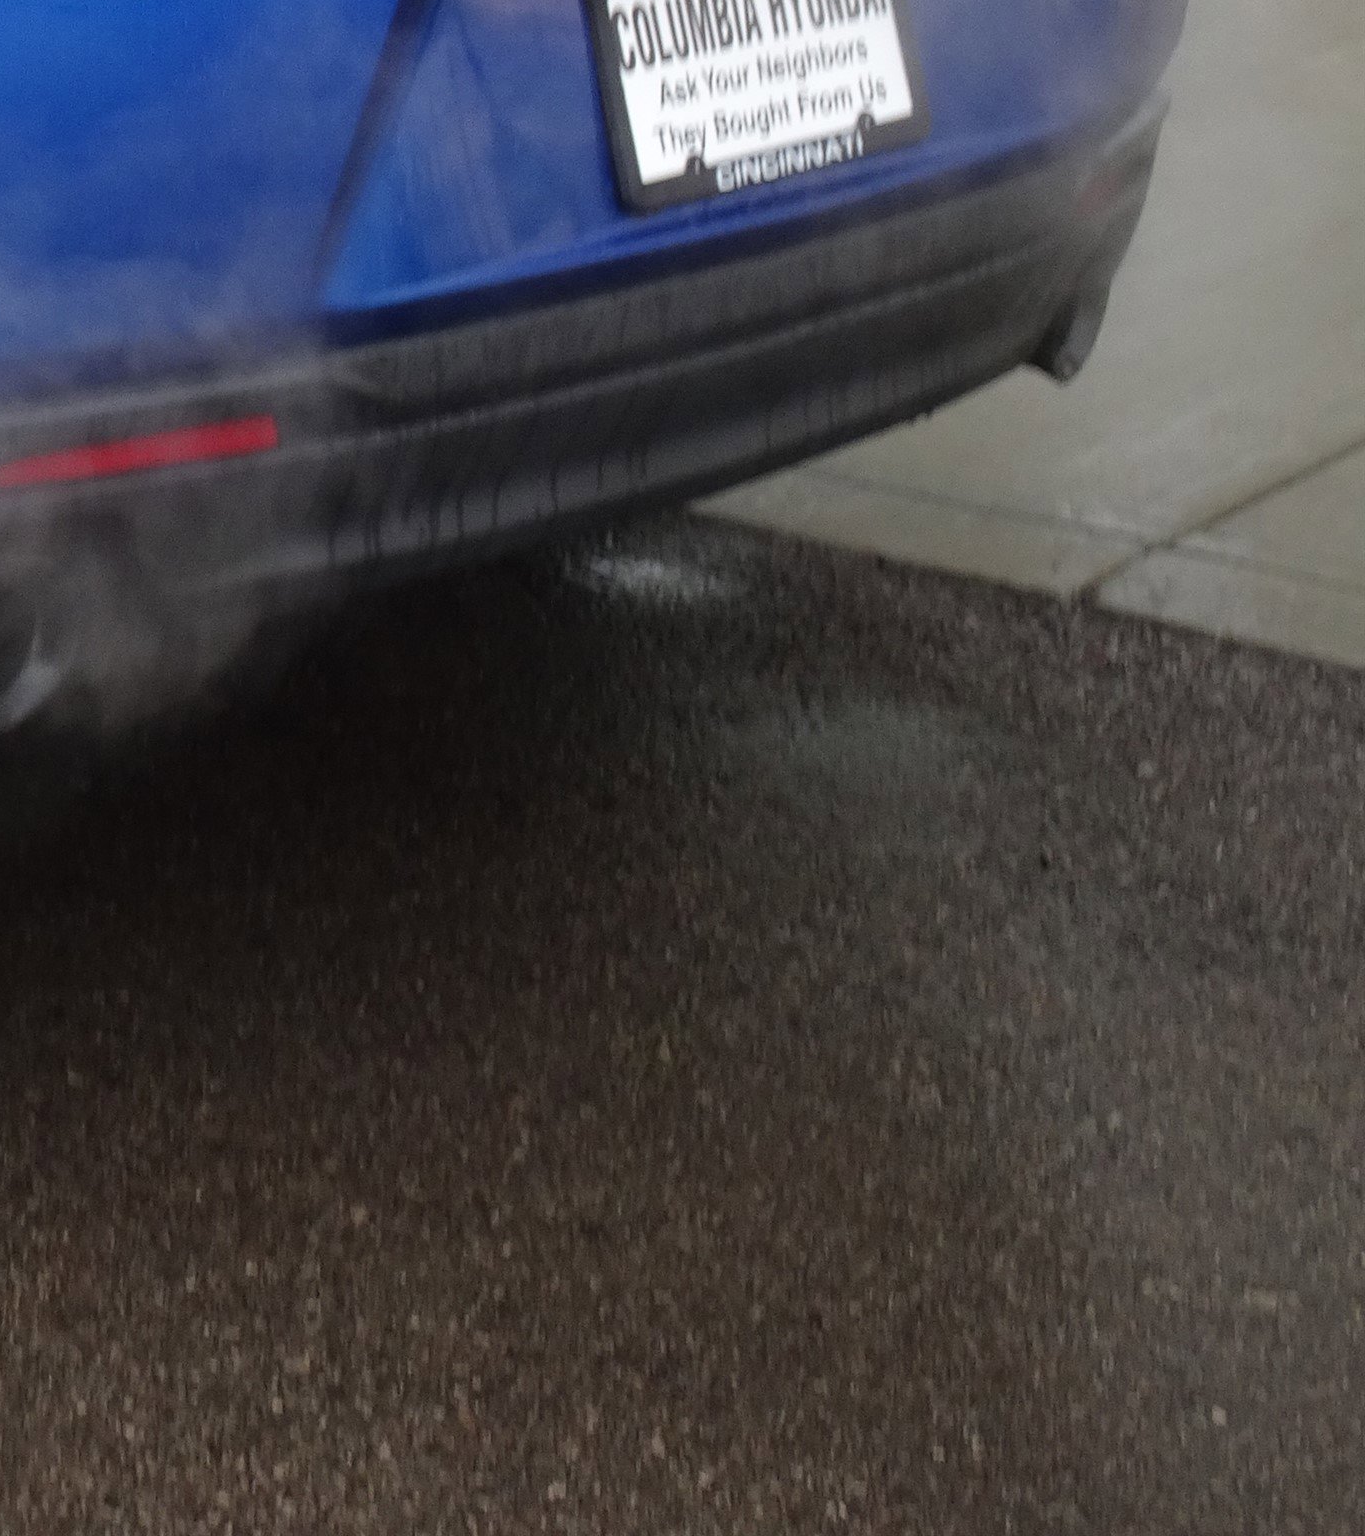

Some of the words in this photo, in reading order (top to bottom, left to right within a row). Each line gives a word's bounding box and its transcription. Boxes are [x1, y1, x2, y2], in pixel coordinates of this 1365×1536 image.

[659, 71, 697, 111] Ask
[705, 61, 749, 96] Your
[757, 35, 868, 85] Neighbors
[653, 120, 707, 156] They
[713, 92, 791, 144] Bought
[797, 81, 853, 121] From
[860, 73, 887, 106] Us
[715, 132, 865, 193] CINCINNATI
